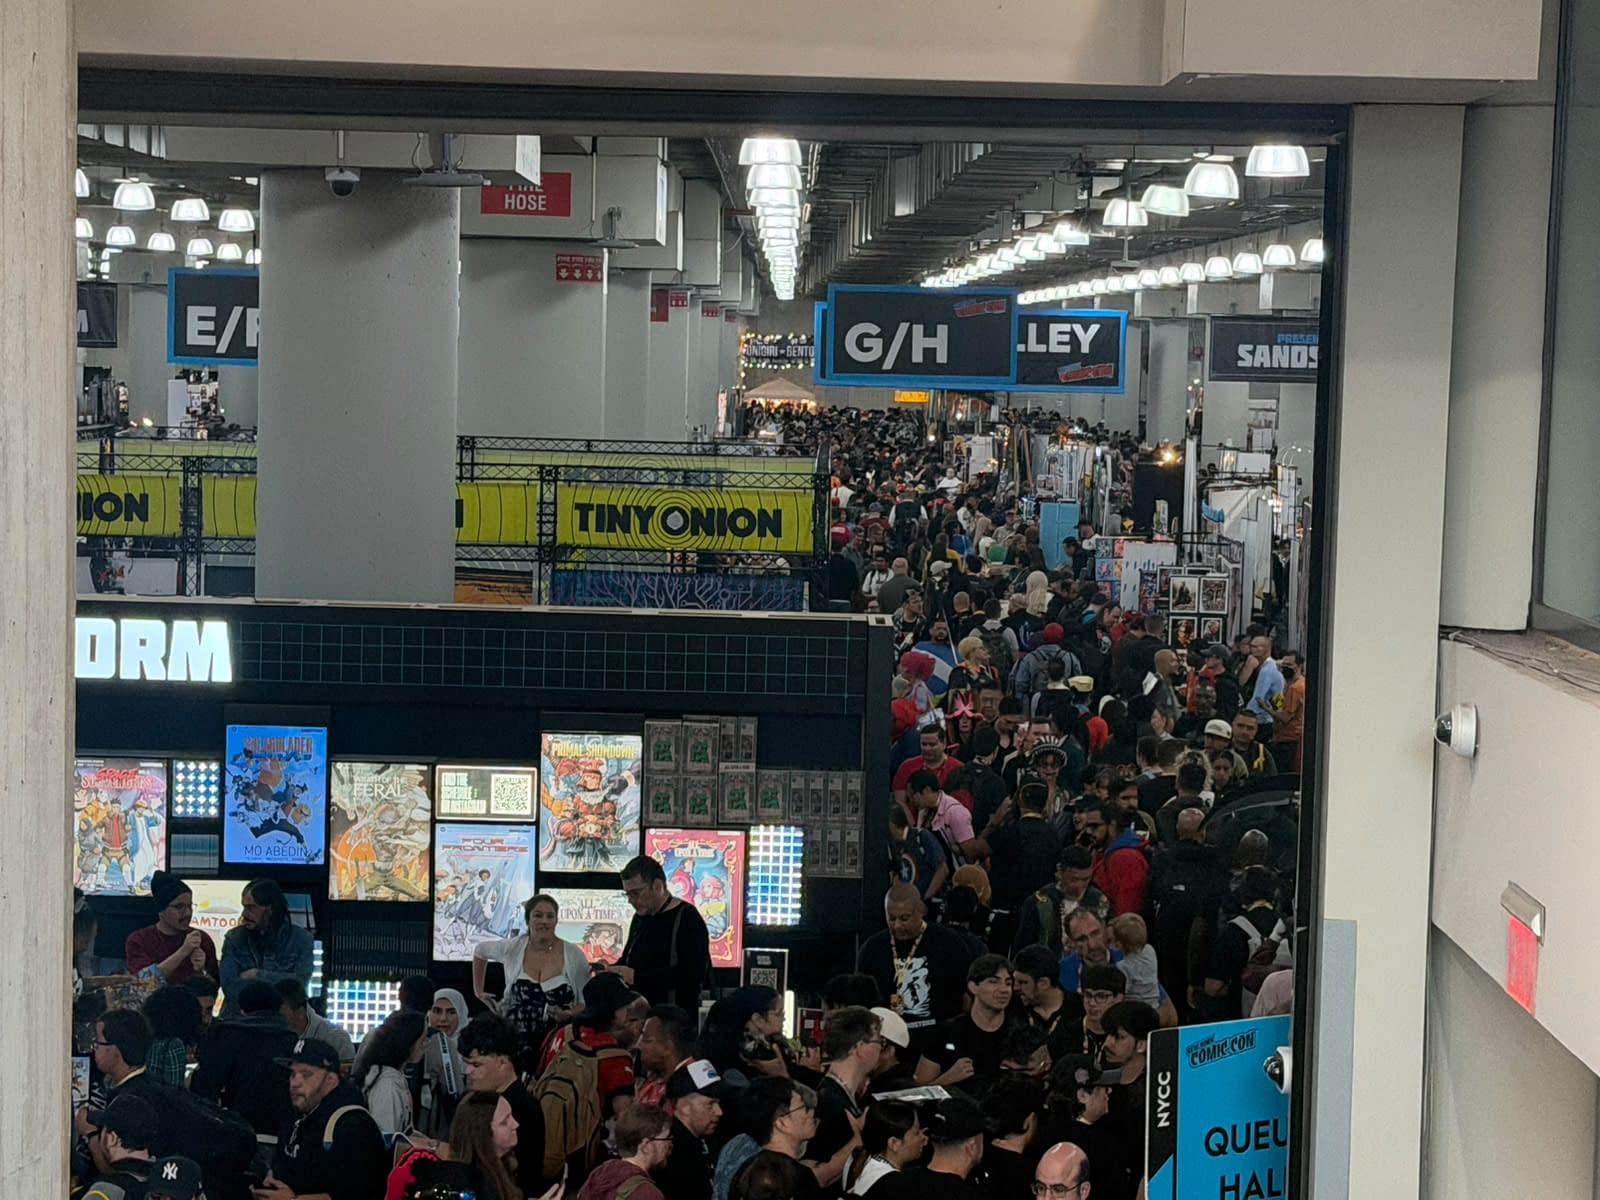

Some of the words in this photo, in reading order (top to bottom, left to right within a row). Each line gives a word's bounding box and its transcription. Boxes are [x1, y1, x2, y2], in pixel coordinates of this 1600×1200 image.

[504, 194, 547, 211] HOSE
[844, 322, 948, 370] G/H
[1017, 323, 1100, 353] LEY
[77, 492, 149, 522] ION
[575, 503, 653, 535] TINY
[660, 506, 782, 539] ONION
[552, 743, 582, 757] PRIMAL
[353, 783, 408, 799] FERAL
[244, 846, 262, 857] MO
[265, 845, 308, 857] ABEDIN
[1157, 1071, 1171, 1128] NYCC
[162, 1161, 178, 1180] NY
[1220, 1166, 1287, 1200] HAL
